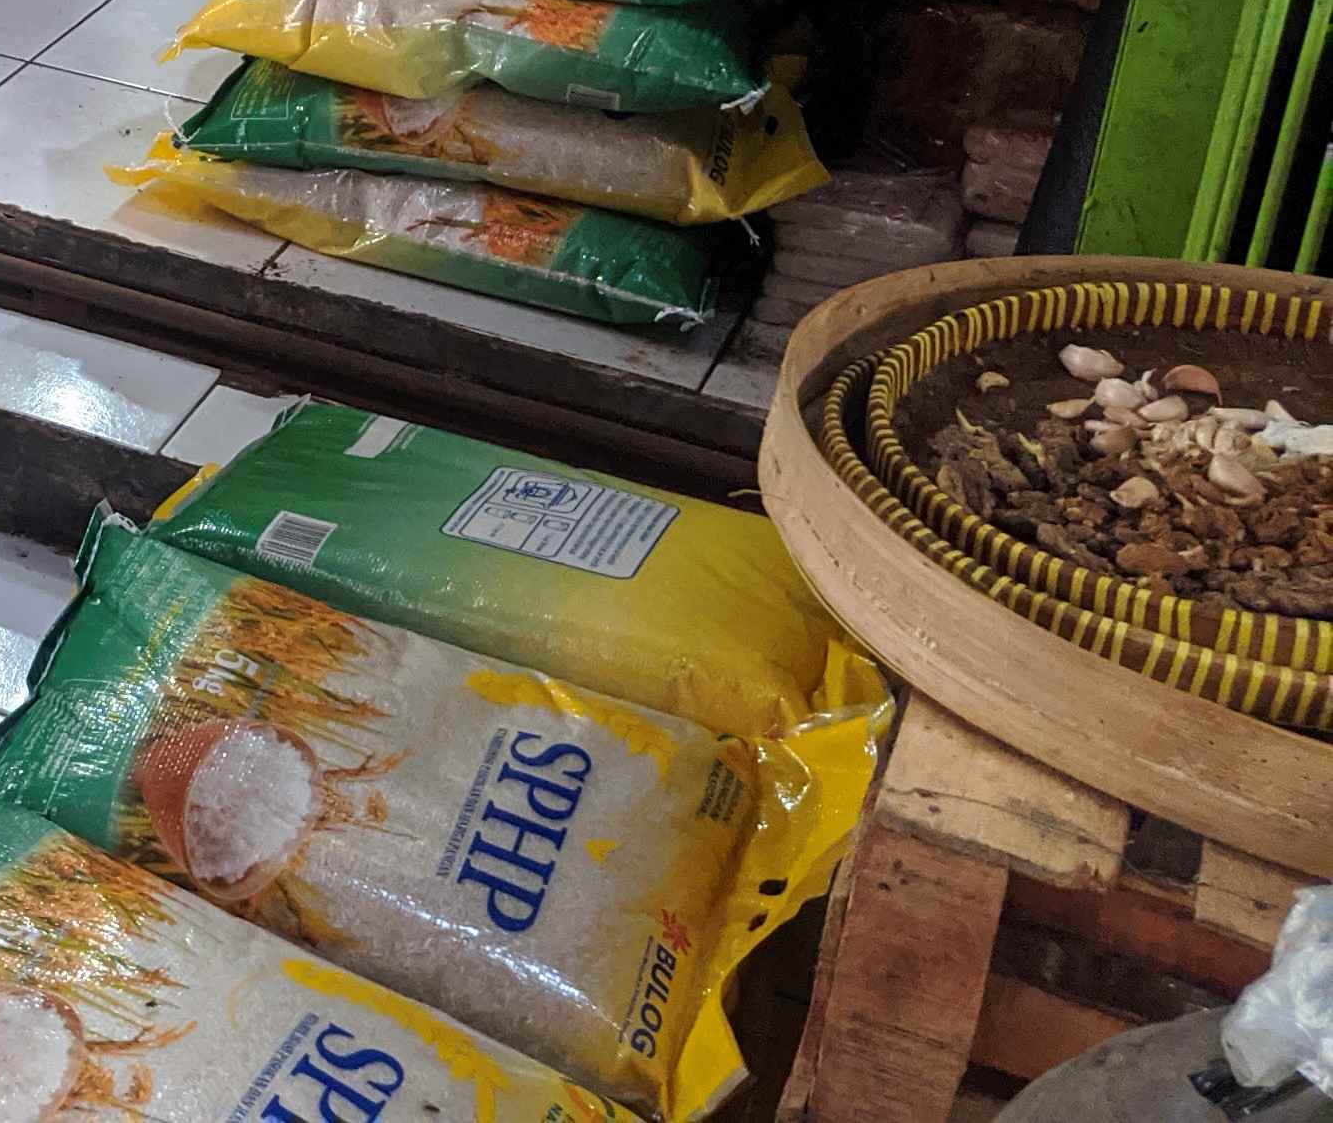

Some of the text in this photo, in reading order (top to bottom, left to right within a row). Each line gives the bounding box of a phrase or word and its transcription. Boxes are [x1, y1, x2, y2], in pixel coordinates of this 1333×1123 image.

[192, 649, 261, 697] 5 kg
[457, 731, 592, 933] SPHP
[631, 943, 677, 1059] BULOG
[261, 1022, 405, 1123] SP
